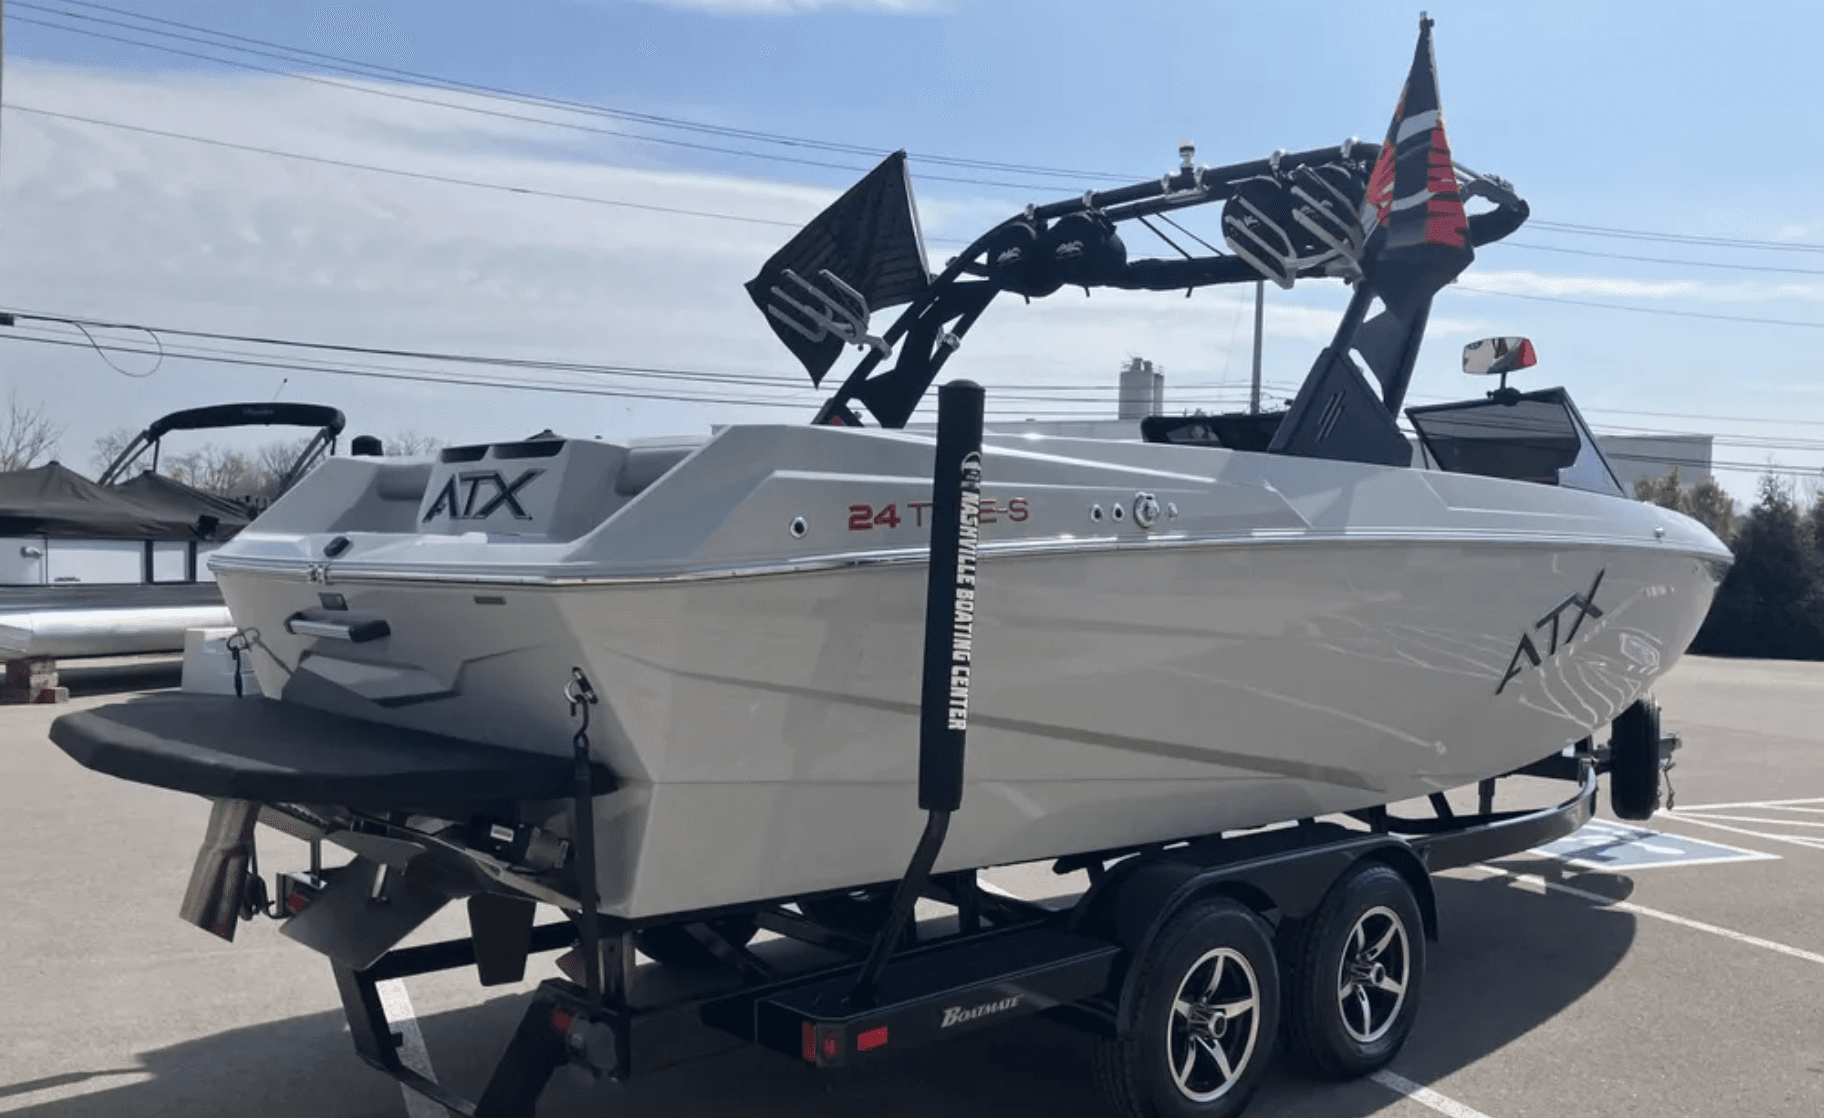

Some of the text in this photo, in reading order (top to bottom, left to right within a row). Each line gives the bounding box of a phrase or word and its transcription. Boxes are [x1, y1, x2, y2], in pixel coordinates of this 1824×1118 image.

[421, 468, 547, 523] ATX
[848, 497, 1028, 531] 24 TE-S
[956, 490, 979, 587] NASHVILLE
[952, 588, 974, 661] BOATING
[1495, 568, 1605, 695] ATX
[947, 665, 970, 730] CENTER
